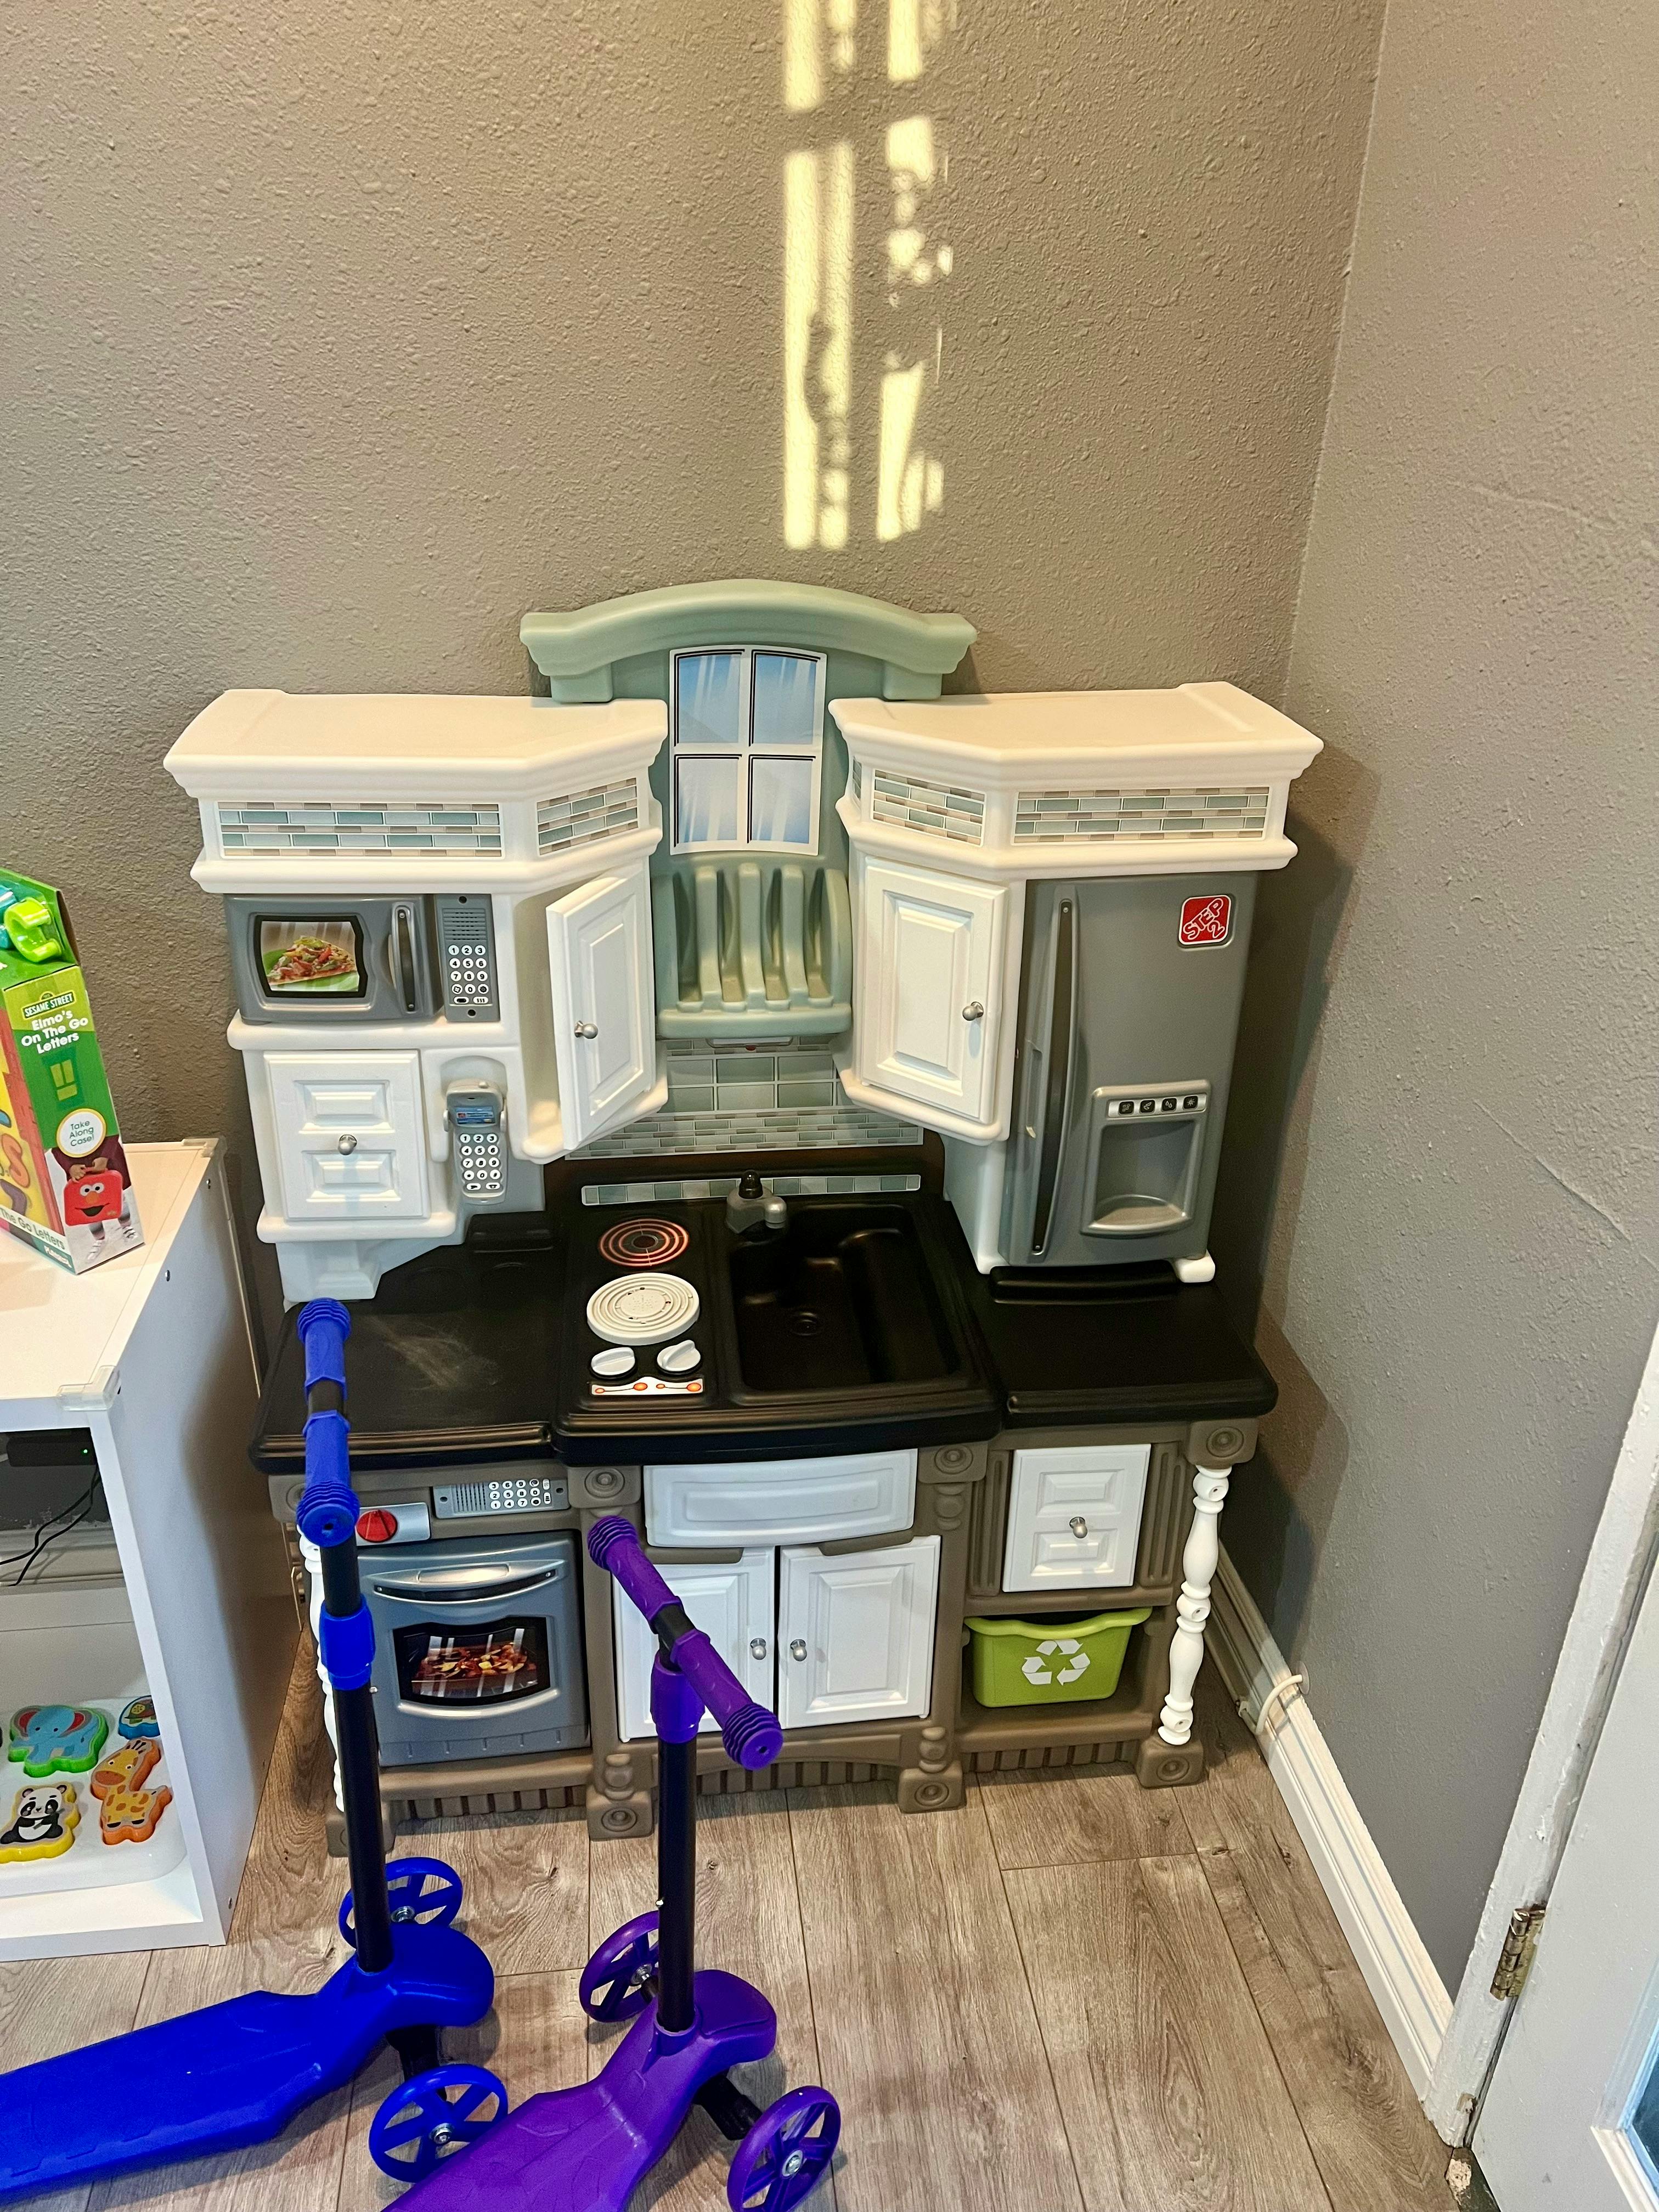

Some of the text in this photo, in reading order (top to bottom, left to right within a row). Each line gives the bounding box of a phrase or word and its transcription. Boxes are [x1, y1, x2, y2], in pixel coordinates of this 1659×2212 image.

[1183, 898, 1223, 940] STEP
[1207, 920, 1225, 939] 2
[24, 993, 73, 1017] SESAME STREET
[31, 1010, 73, 1031] Elmo's
[21, 1018, 88, 1046] On The Go
[36, 1032, 79, 1054] Letters
[70, 1121, 90, 1130] Take
[70, 1127, 94, 1139] Along
[18, 1217, 32, 1232] Go
[33, 1224, 65, 1250] Letters
